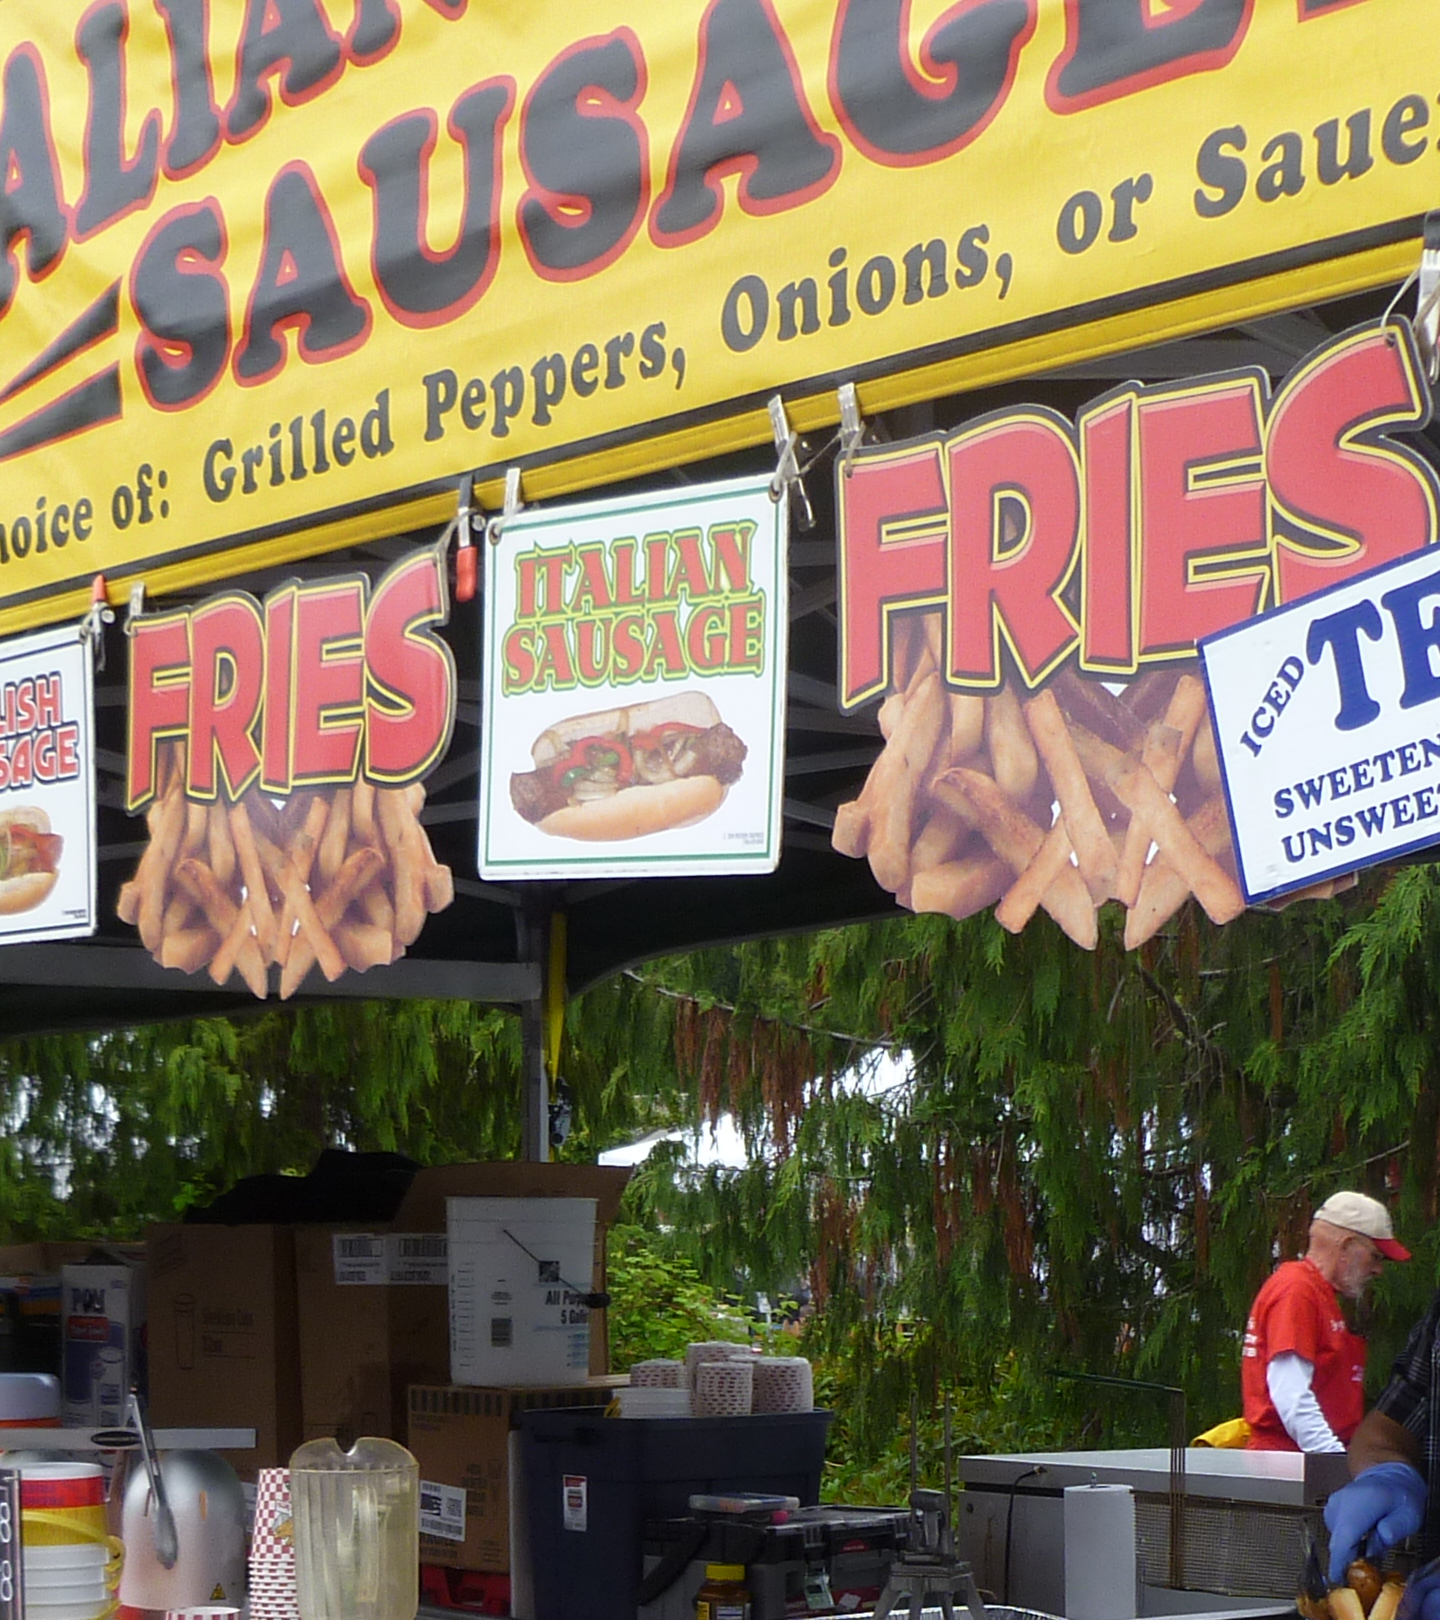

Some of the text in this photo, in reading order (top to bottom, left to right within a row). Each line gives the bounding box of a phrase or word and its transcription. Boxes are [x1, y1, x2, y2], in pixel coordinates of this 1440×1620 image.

[110, 463, 171, 531] of:
[202, 384, 394, 506] Grilled
[421, 319, 688, 445] Peppers,
[719, 225, 1014, 354] Onions,
[1054, 169, 1154, 252] or
[514, 520, 759, 620] ITALIAN
[128, 553, 456, 811] FRIES
[503, 594, 764, 696] SAUSAGE
[1240, 655, 1305, 758] ICED
